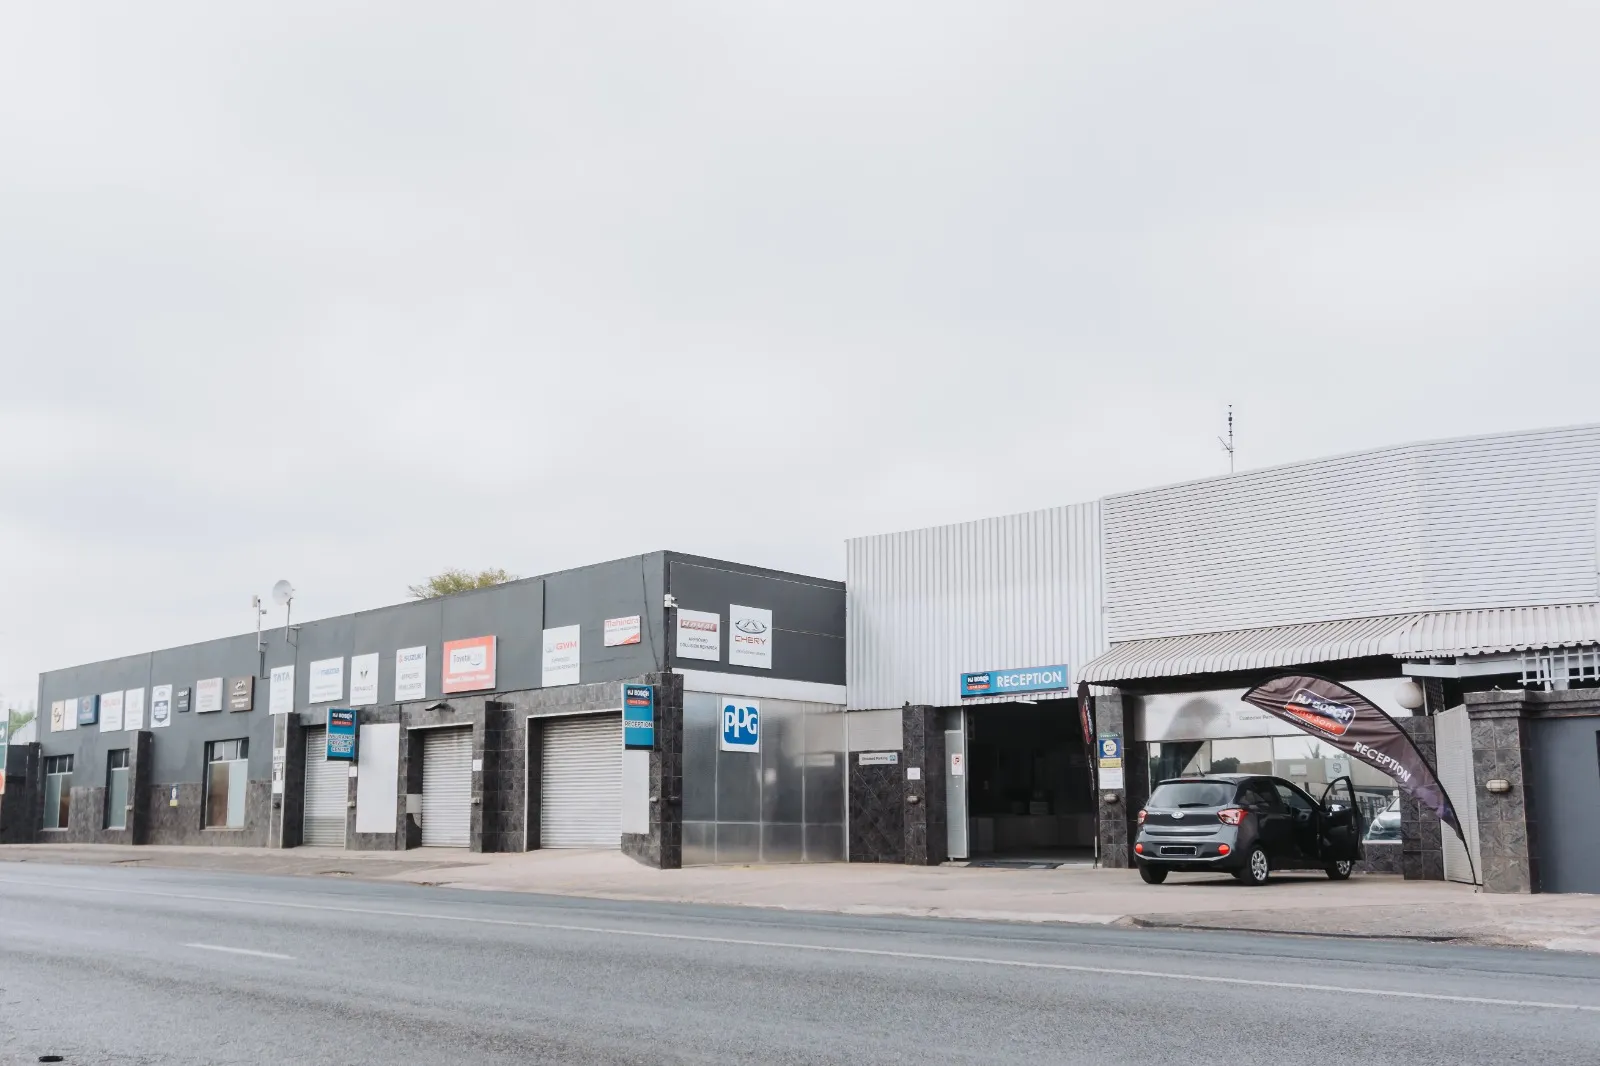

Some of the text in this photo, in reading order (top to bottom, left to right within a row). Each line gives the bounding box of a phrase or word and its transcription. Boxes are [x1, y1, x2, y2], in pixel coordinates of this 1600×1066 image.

[555, 641, 577, 651] GWM
[735, 635, 767, 645] CHERY
[273, 671, 291, 683] TATA
[996, 671, 1062, 688] RECEPTION
[1295, 693, 1311, 705] HJ
[1312, 700, 1352, 721] BOSCH
[724, 705, 758, 738] PPG
[1353, 741, 1412, 783] RECEPTION
